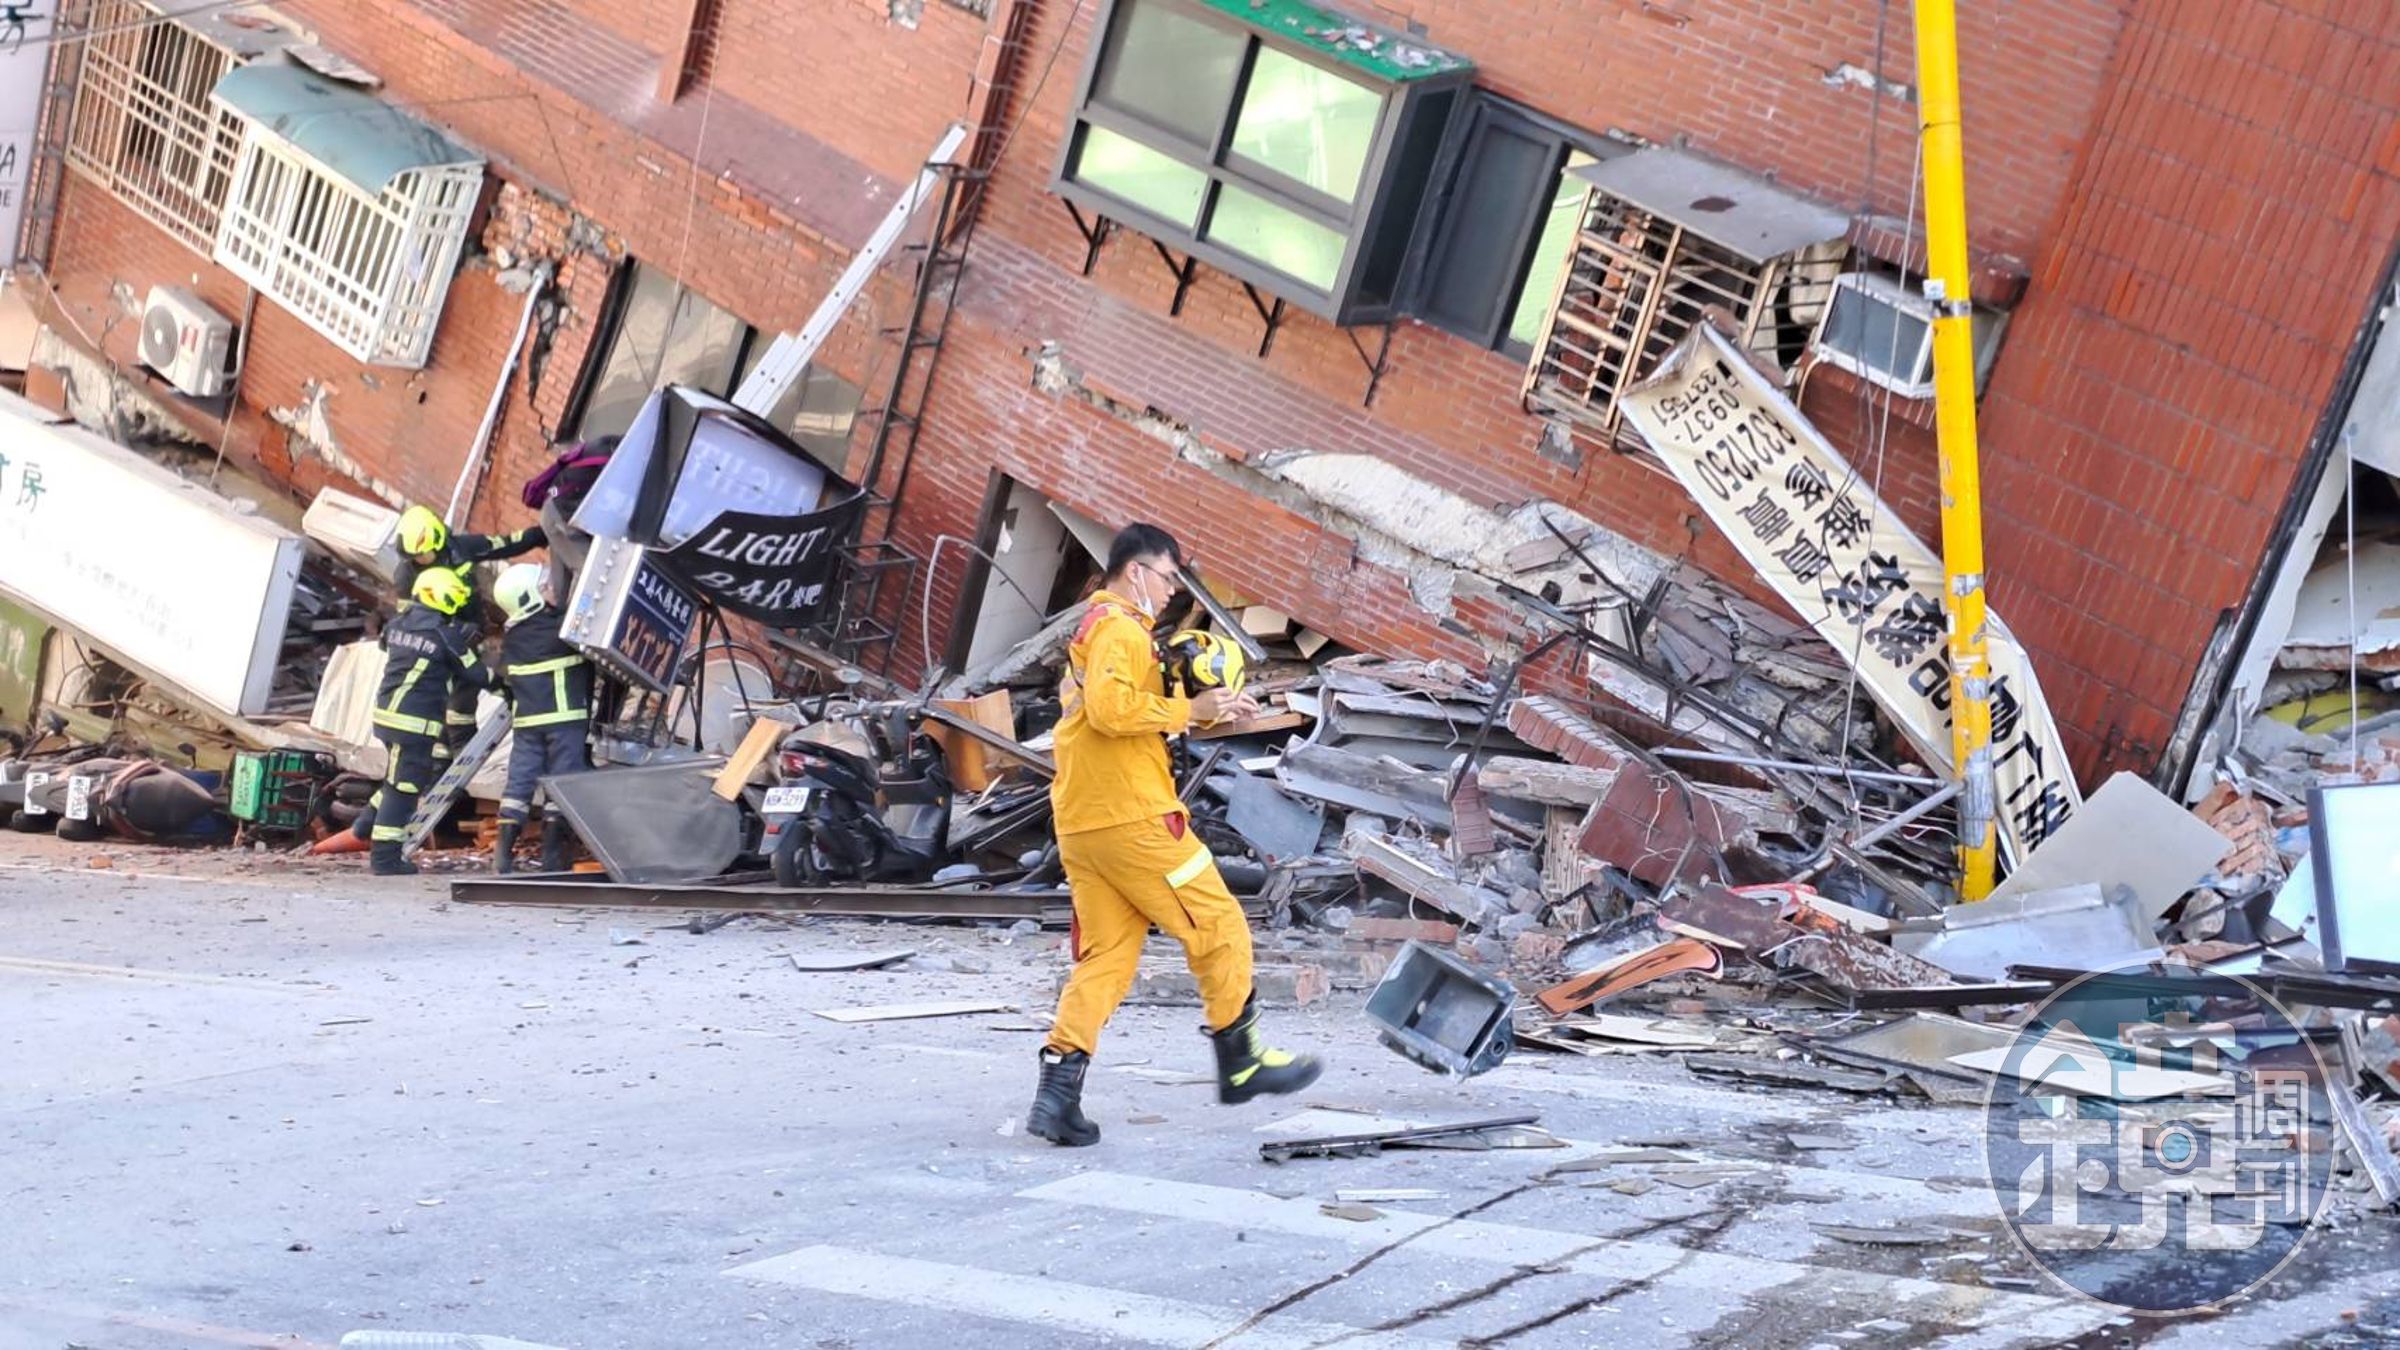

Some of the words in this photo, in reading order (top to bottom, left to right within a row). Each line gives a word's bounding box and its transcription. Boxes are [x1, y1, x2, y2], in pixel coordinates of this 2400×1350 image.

[1651, 369, 1717, 427] 337551
[1694, 406, 1797, 501] 8321250
[1735, 487, 1832, 586] 買賣
[1784, 455, 1871, 549] 維修
[698, 526, 827, 567] LIGHT
[694, 571, 793, 610] BAR
